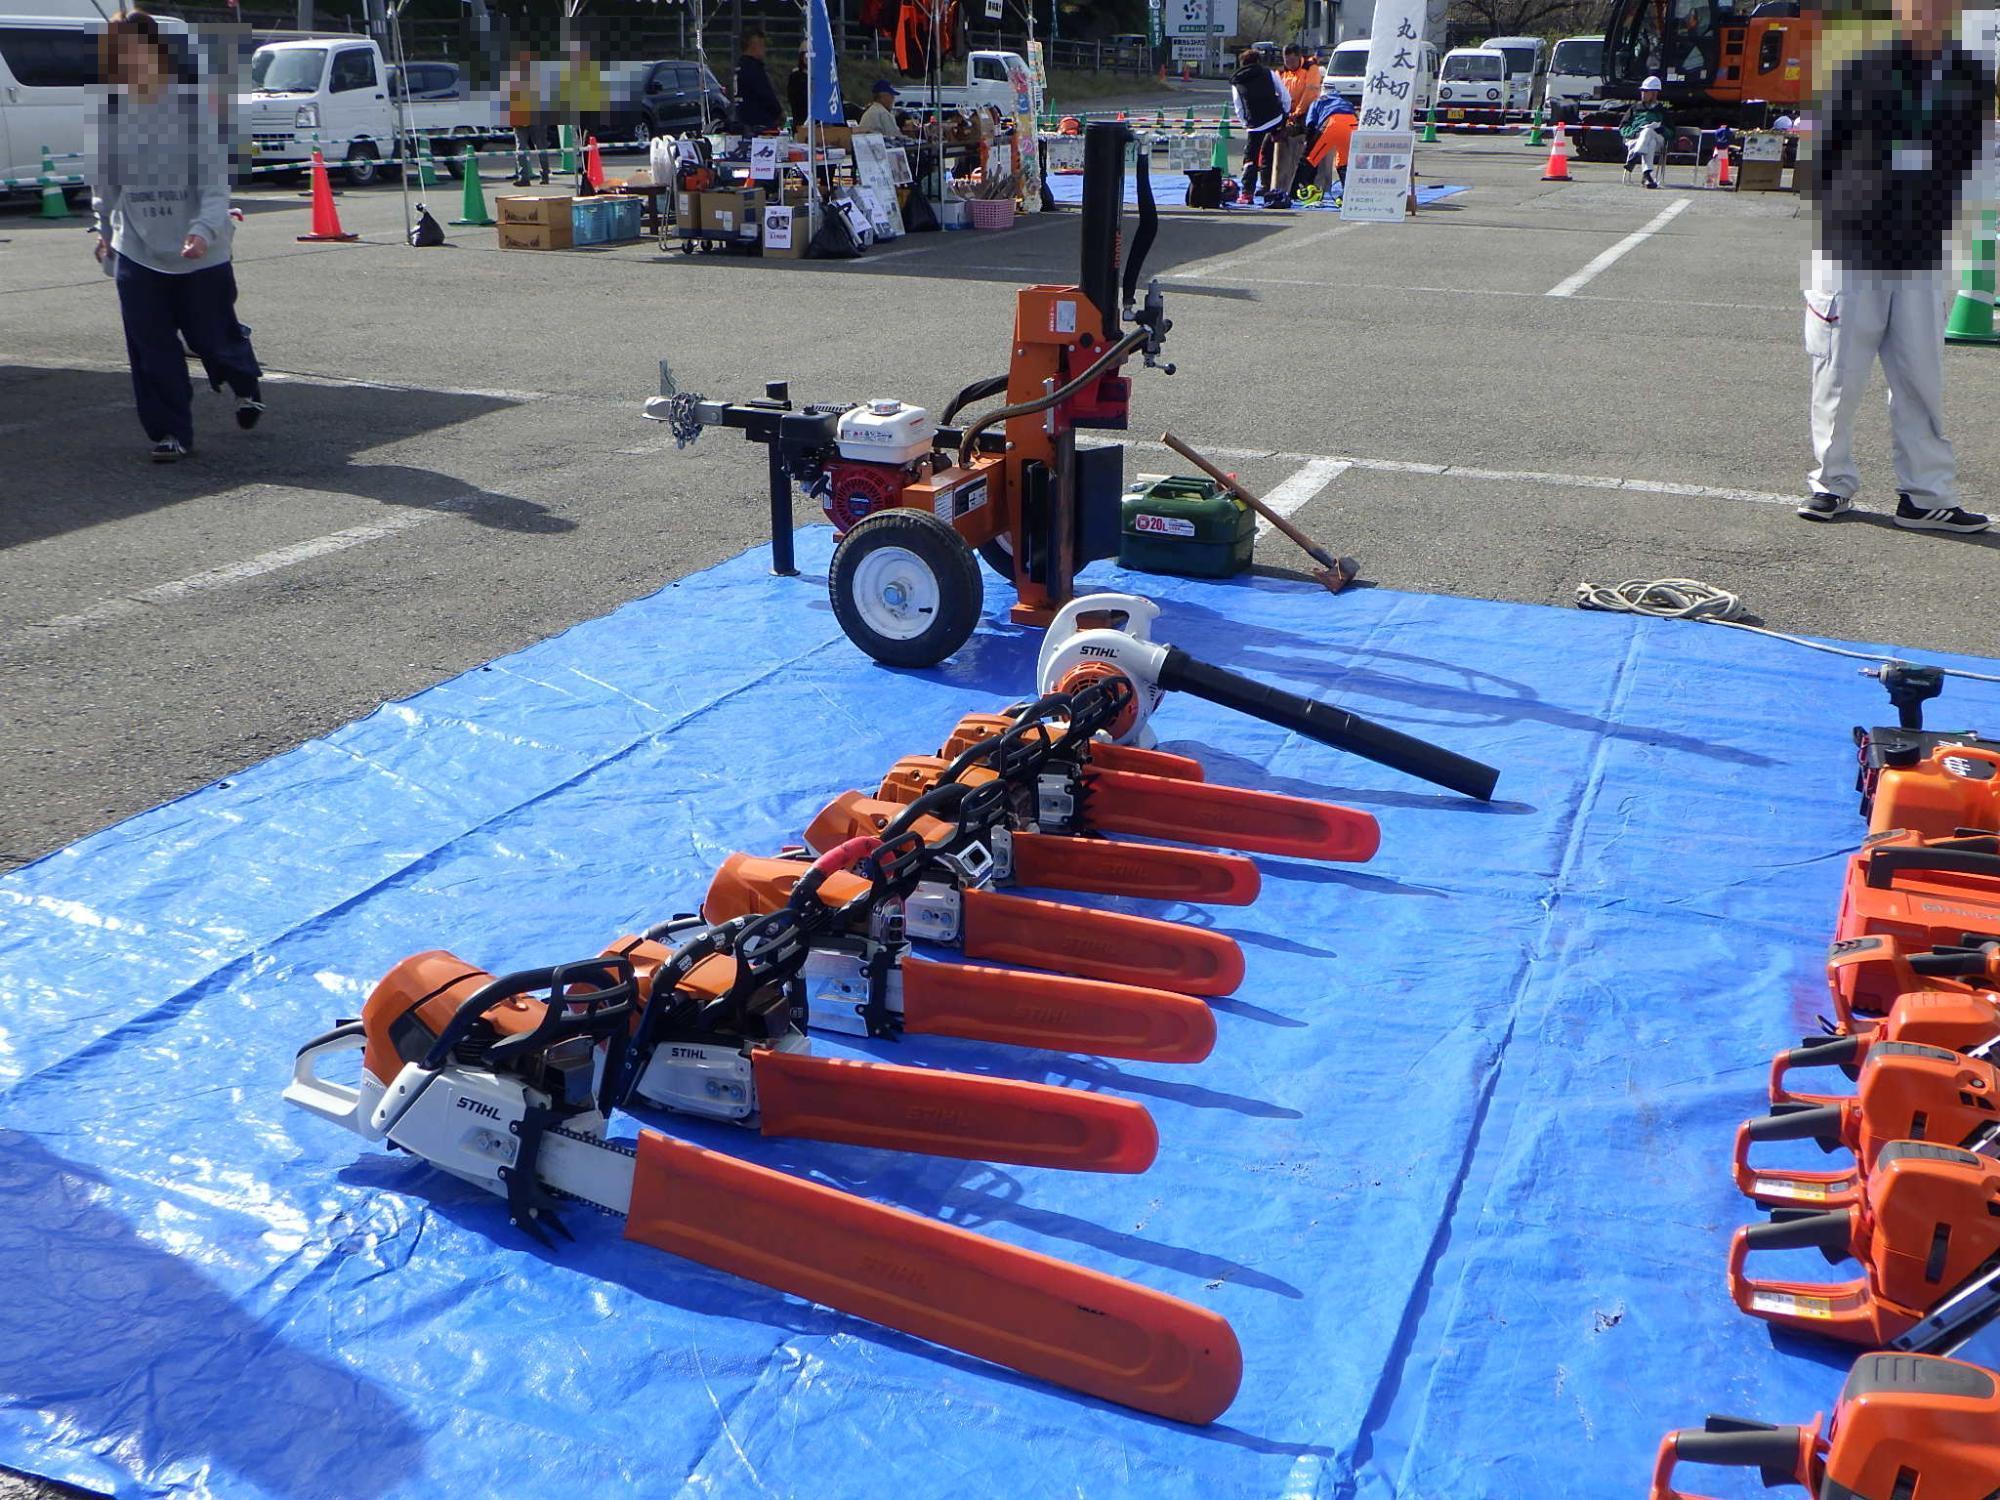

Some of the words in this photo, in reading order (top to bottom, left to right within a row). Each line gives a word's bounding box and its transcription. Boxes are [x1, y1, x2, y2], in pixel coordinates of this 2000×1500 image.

[1388, 17, 1417, 131] 丸太切り
[1361, 71, 1390, 127] 体験
[1151, 517, 1168, 531] 20L
[1080, 645, 1118, 658] STIHL
[671, 1047, 707, 1060] STIHL
[457, 1096, 501, 1120] STIHL
